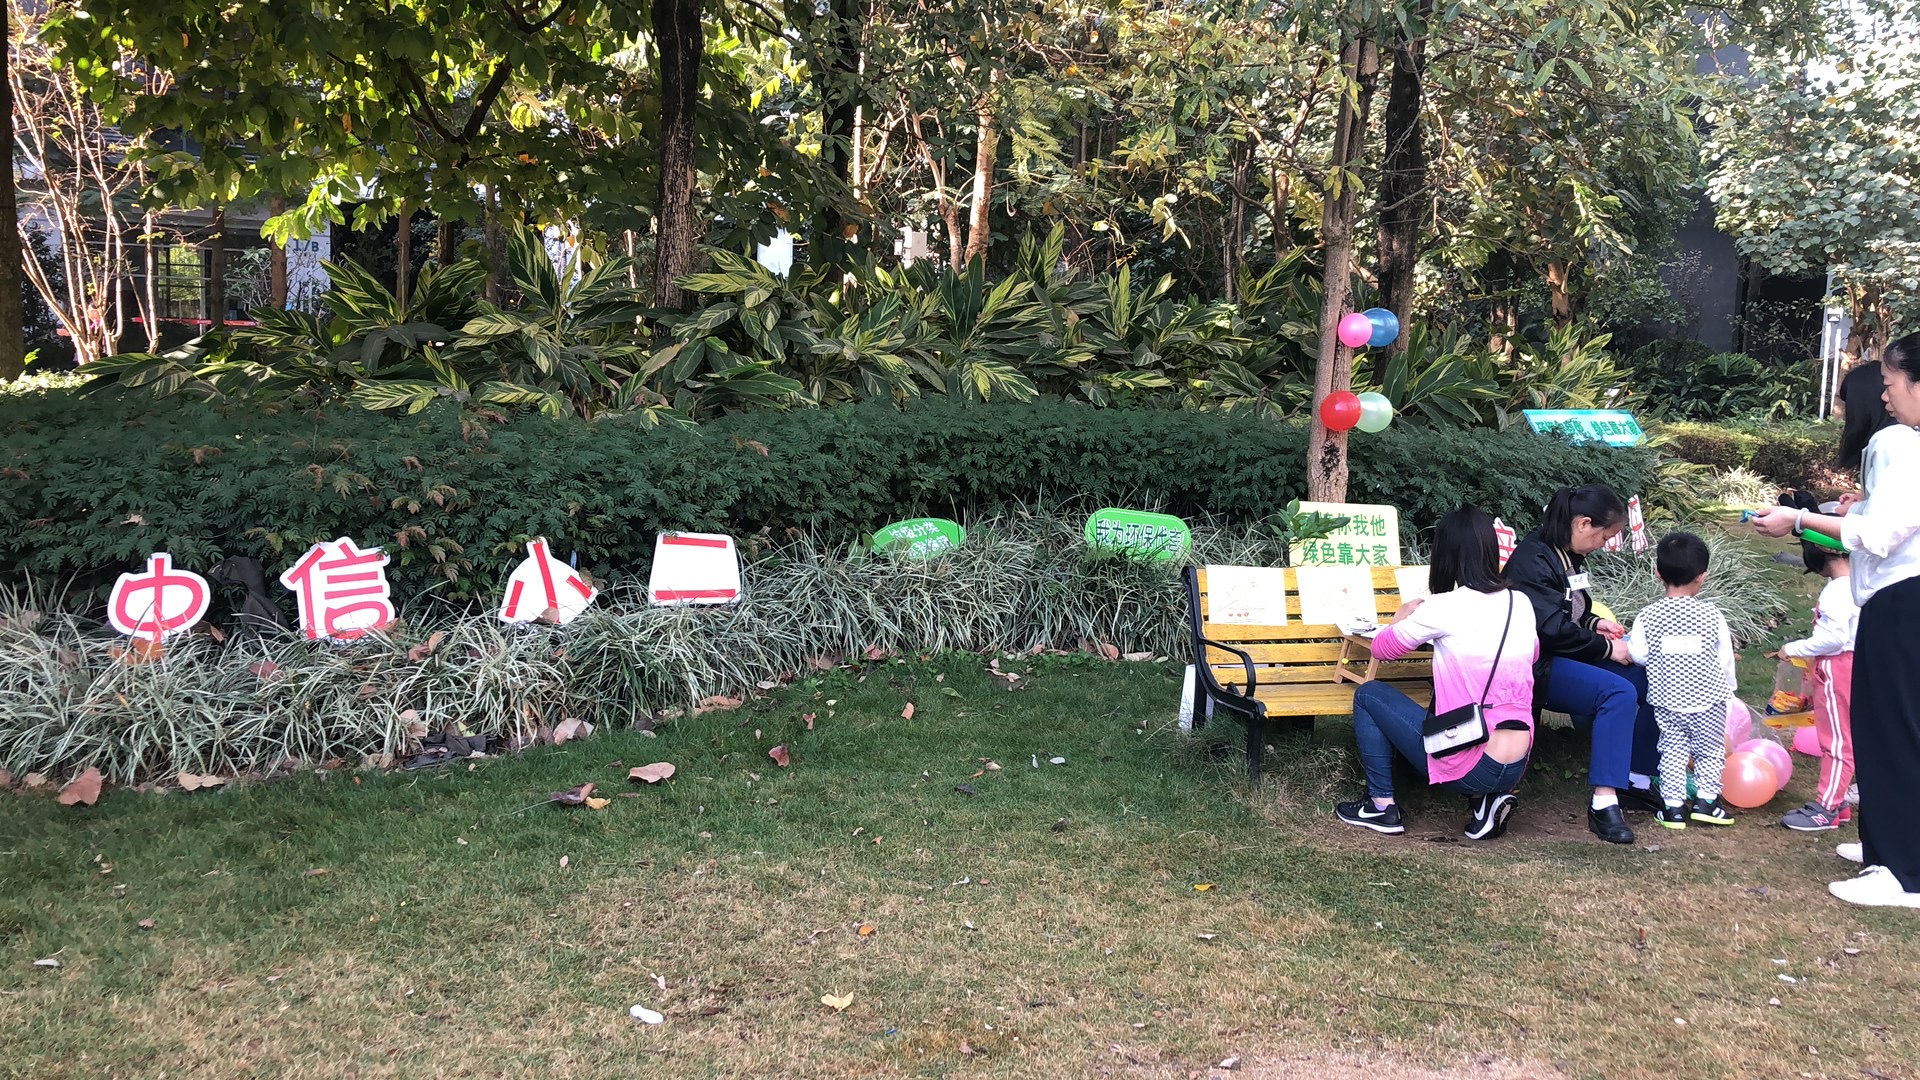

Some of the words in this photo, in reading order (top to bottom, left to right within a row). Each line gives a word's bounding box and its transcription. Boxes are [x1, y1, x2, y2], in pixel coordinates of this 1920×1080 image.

[887, 521, 940, 539] 垃圾分类
[1096, 518, 1184, 553] 我为环保代言
[1302, 512, 1387, 537] 你我他
[655, 535, 736, 600] 二
[1302, 541, 1389, 567] 绿色靠大家
[115, 557, 203, 643] 中
[287, 542, 389, 639] 信
[504, 543, 593, 623] 小
